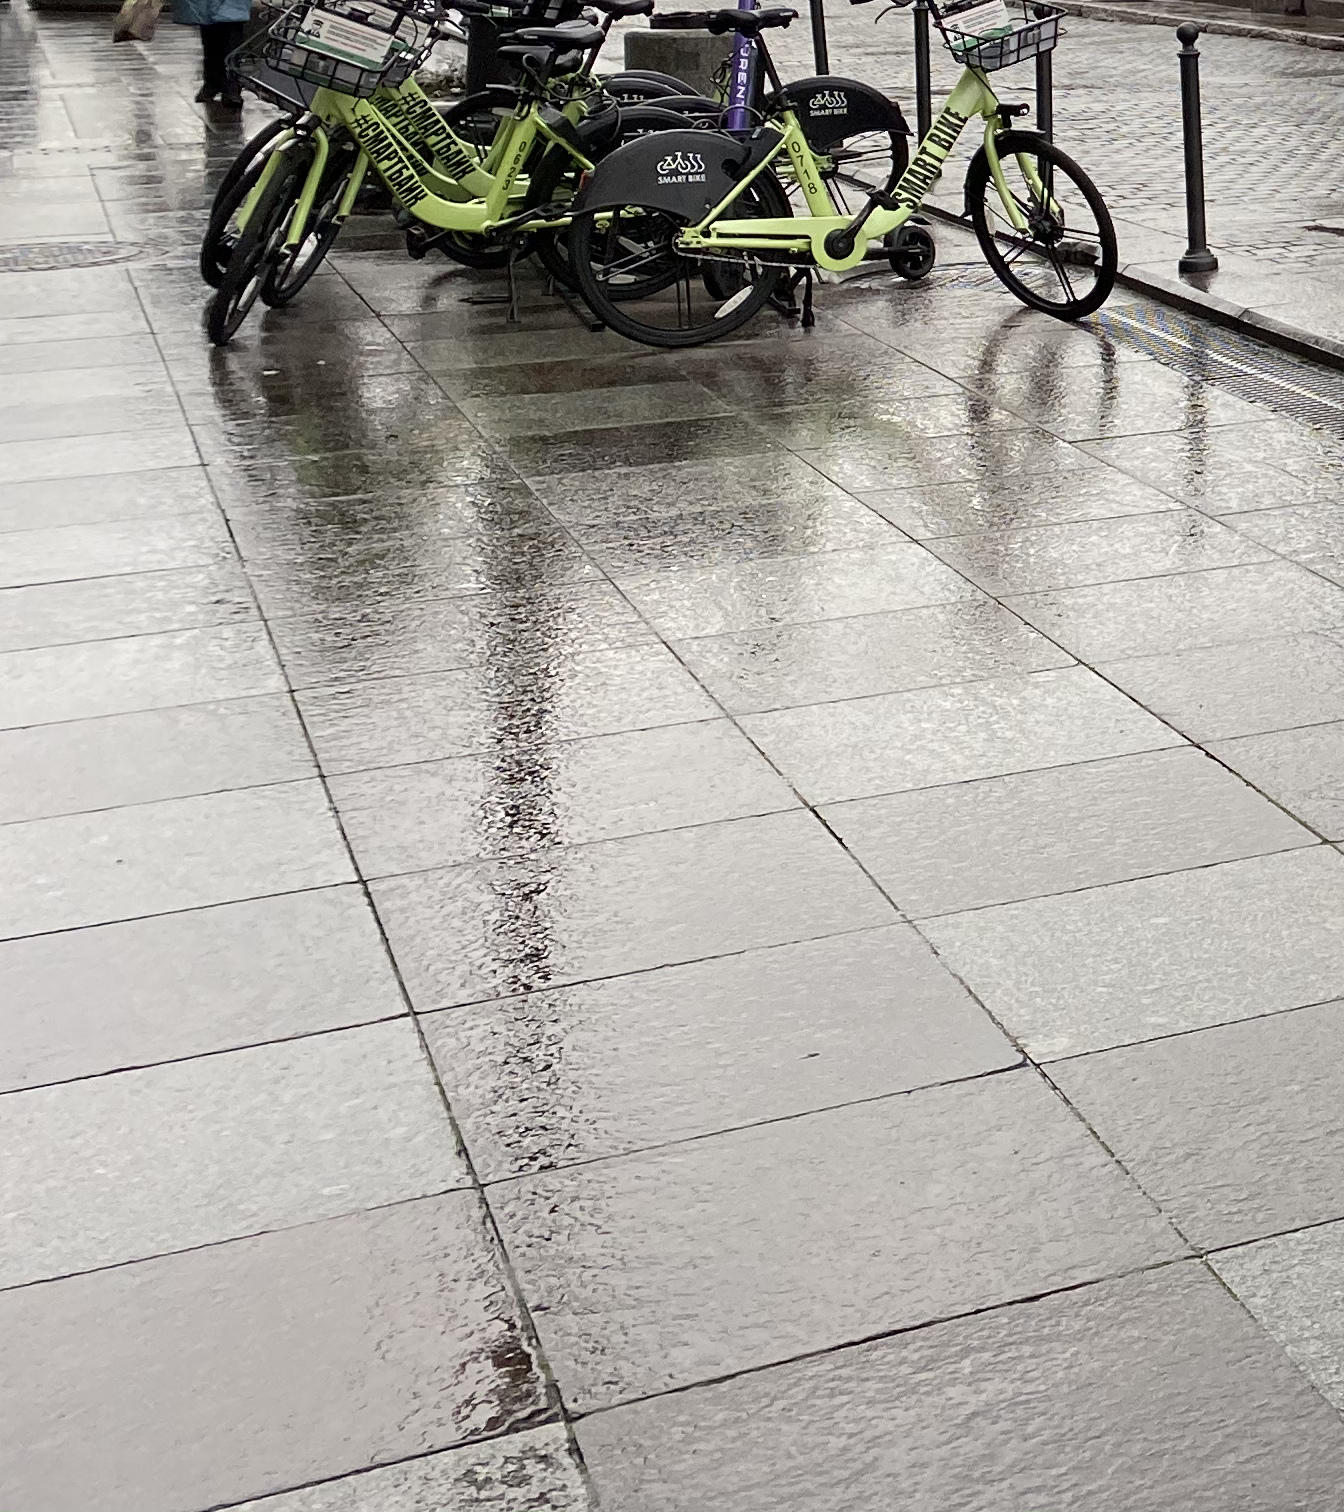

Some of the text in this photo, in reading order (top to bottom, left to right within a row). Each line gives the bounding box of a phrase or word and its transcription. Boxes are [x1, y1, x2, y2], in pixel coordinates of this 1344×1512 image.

[350, 113, 429, 209] #СМАРТБАНК
[399, 91, 476, 182] #СМАРТБАНК
[502, 141, 527, 190] 0623
[791, 141, 818, 195] 0718
[890, 106, 969, 211] SMART BIKE
[657, 173, 707, 185] SMART BIKE
